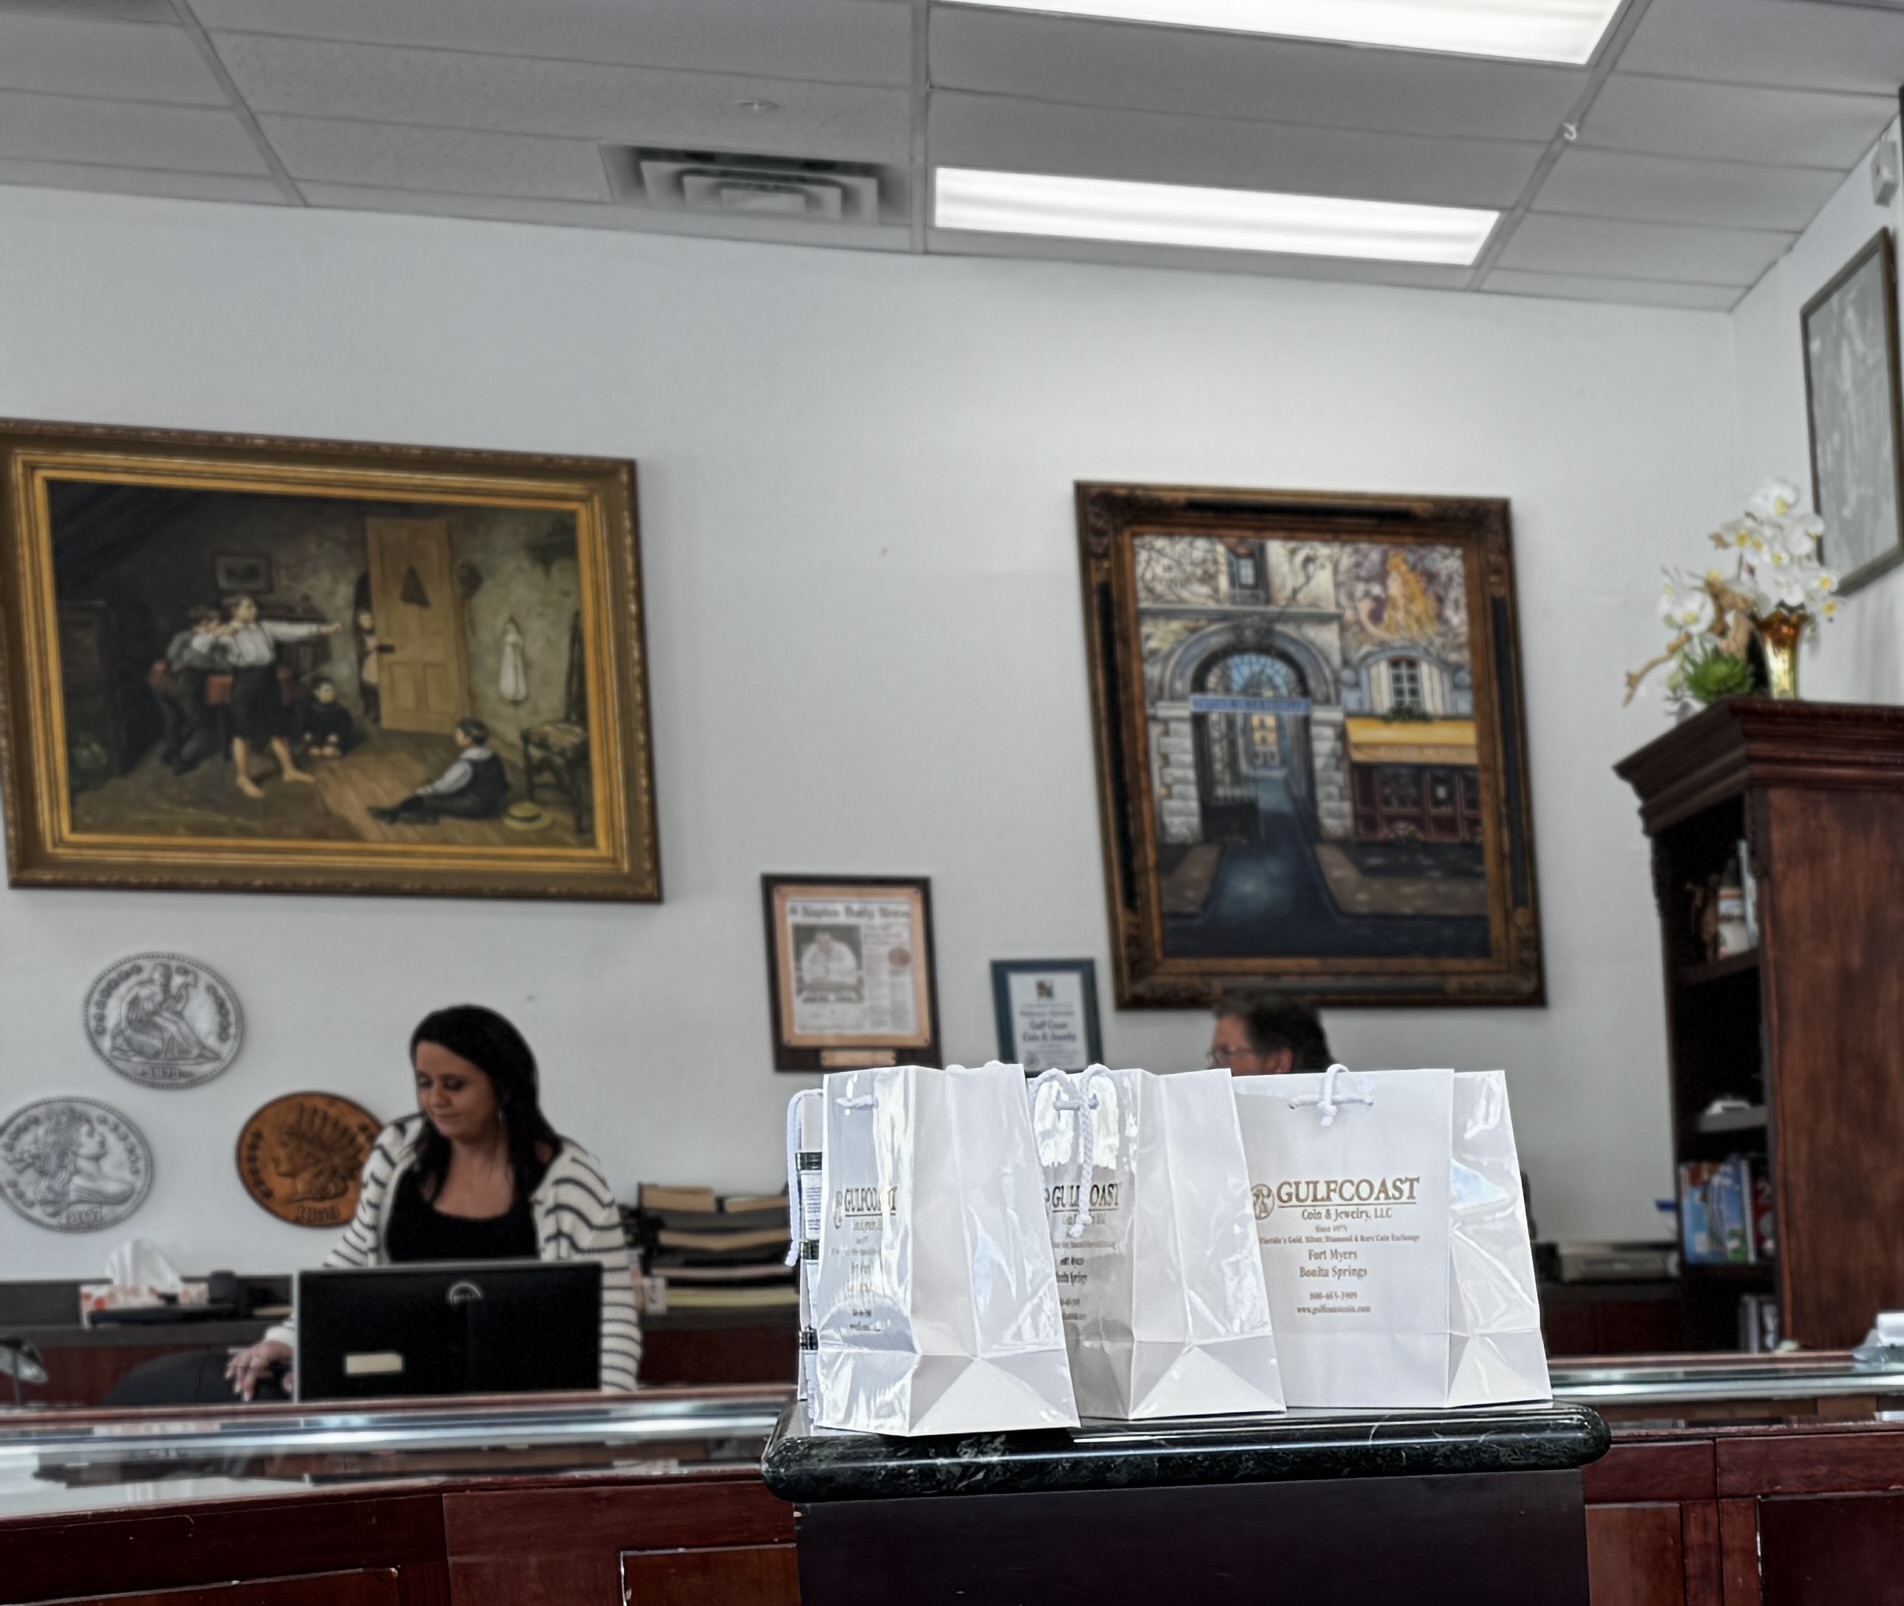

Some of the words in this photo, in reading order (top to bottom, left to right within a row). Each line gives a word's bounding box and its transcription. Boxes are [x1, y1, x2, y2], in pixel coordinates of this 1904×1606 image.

[1276, 1176, 1420, 1204] GULFCOAST
[1301, 1208, 1322, 1220] Coin
[1325, 1208, 1332, 1220] &
[1374, 1207, 1392, 1219] LLC
[1308, 1249, 1327, 1261] Fort
[1330, 1249, 1358, 1263] Myers
[1299, 1266, 1330, 1278] Bonita
[1331, 1266, 1368, 1280] Springs
